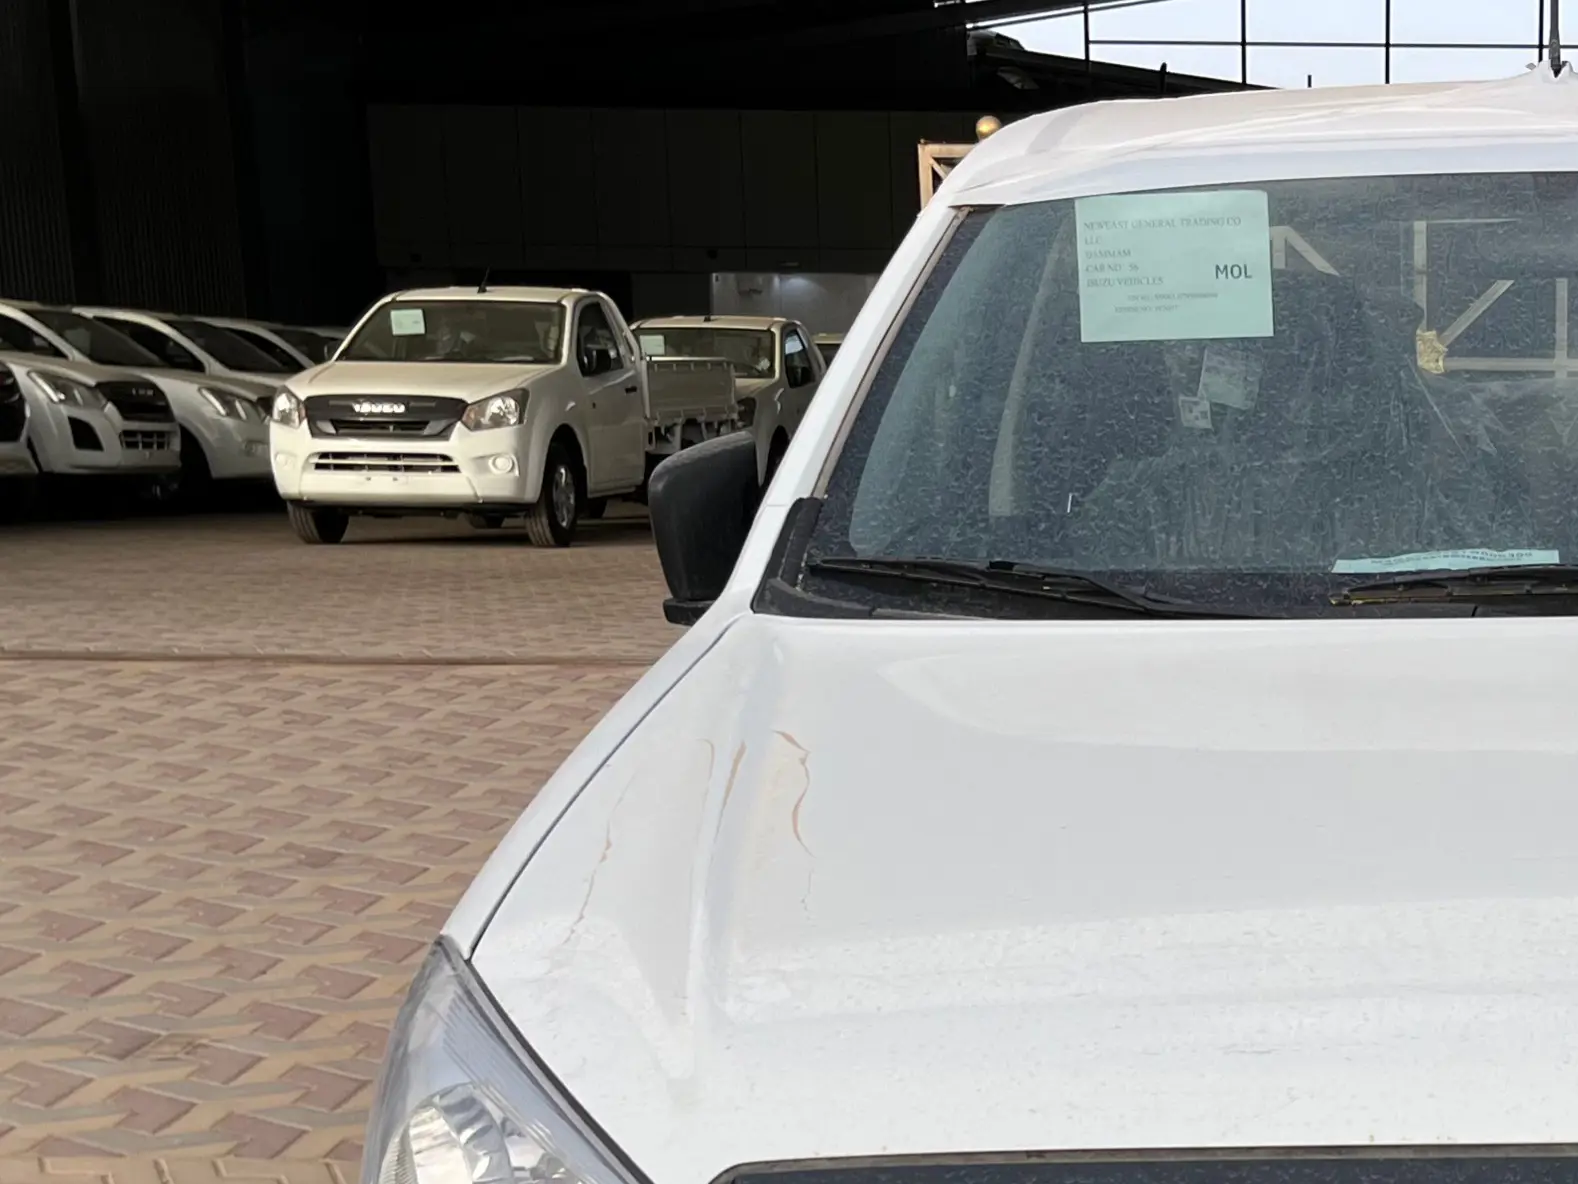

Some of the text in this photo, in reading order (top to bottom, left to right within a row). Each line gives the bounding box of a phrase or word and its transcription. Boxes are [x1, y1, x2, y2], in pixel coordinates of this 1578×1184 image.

[1131, 218, 1177, 229] GENERAL
[1180, 217, 1225, 227] TRADING
[1085, 249, 1132, 260] DAMMAM
[1215, 263, 1253, 280] MOL
[1116, 276, 1164, 287] VEHICLES
